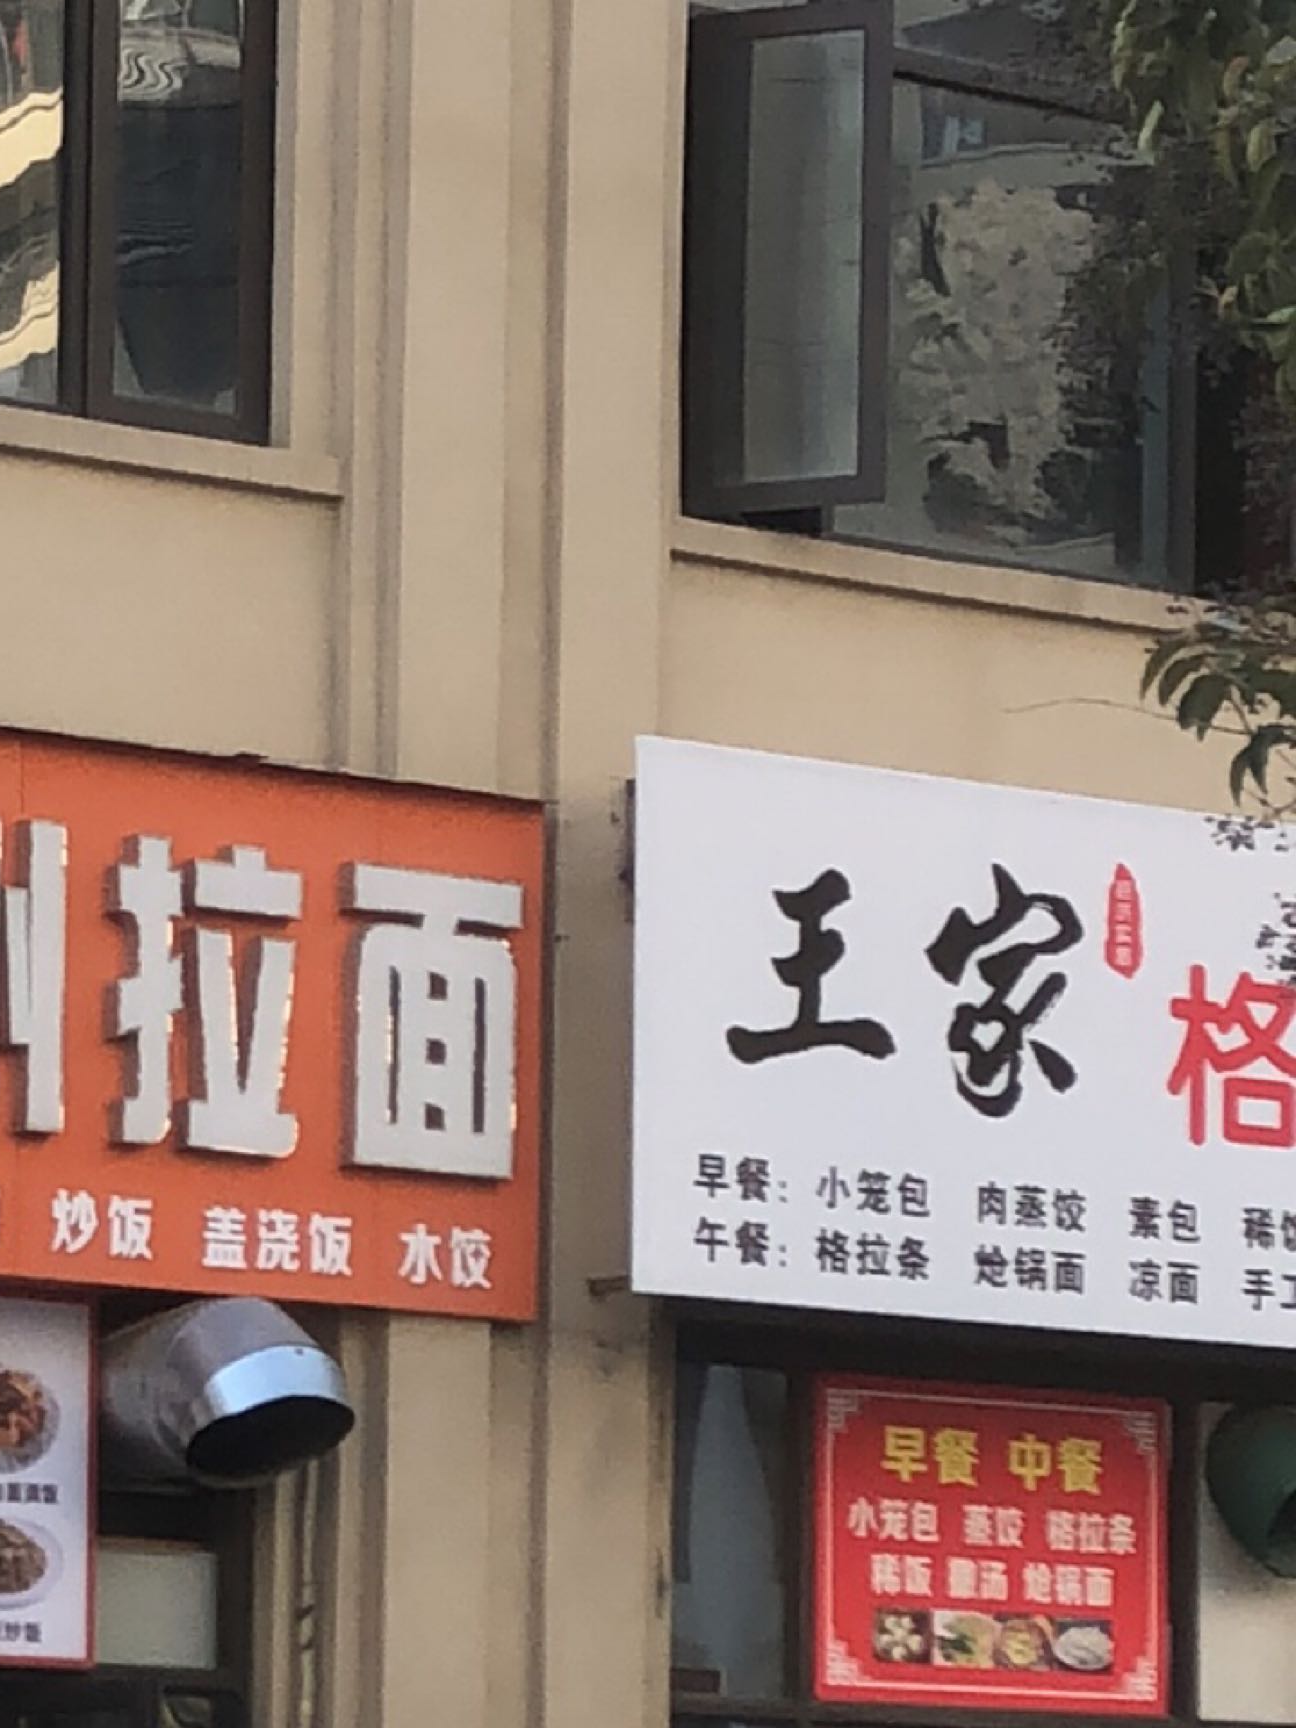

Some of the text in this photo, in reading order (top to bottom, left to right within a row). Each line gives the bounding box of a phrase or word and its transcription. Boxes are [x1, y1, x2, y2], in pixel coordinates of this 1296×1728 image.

[725, 863, 1084, 1118] 王家
[1166, 964, 1296, 1147] 格
[50, 1189, 153, 1261] 炒饭
[201, 1206, 353, 1277] 盖浇饭
[398, 1224, 492, 1289] 水饺
[977, 1181, 1087, 1233] 肉蒸饺
[1129, 1196, 1201, 1244] 素包
[1128, 1257, 1201, 1305] 凉面
[880, 1425, 1103, 1496] 早餐 中餐
[847, 1497, 939, 1543] 小笼包
